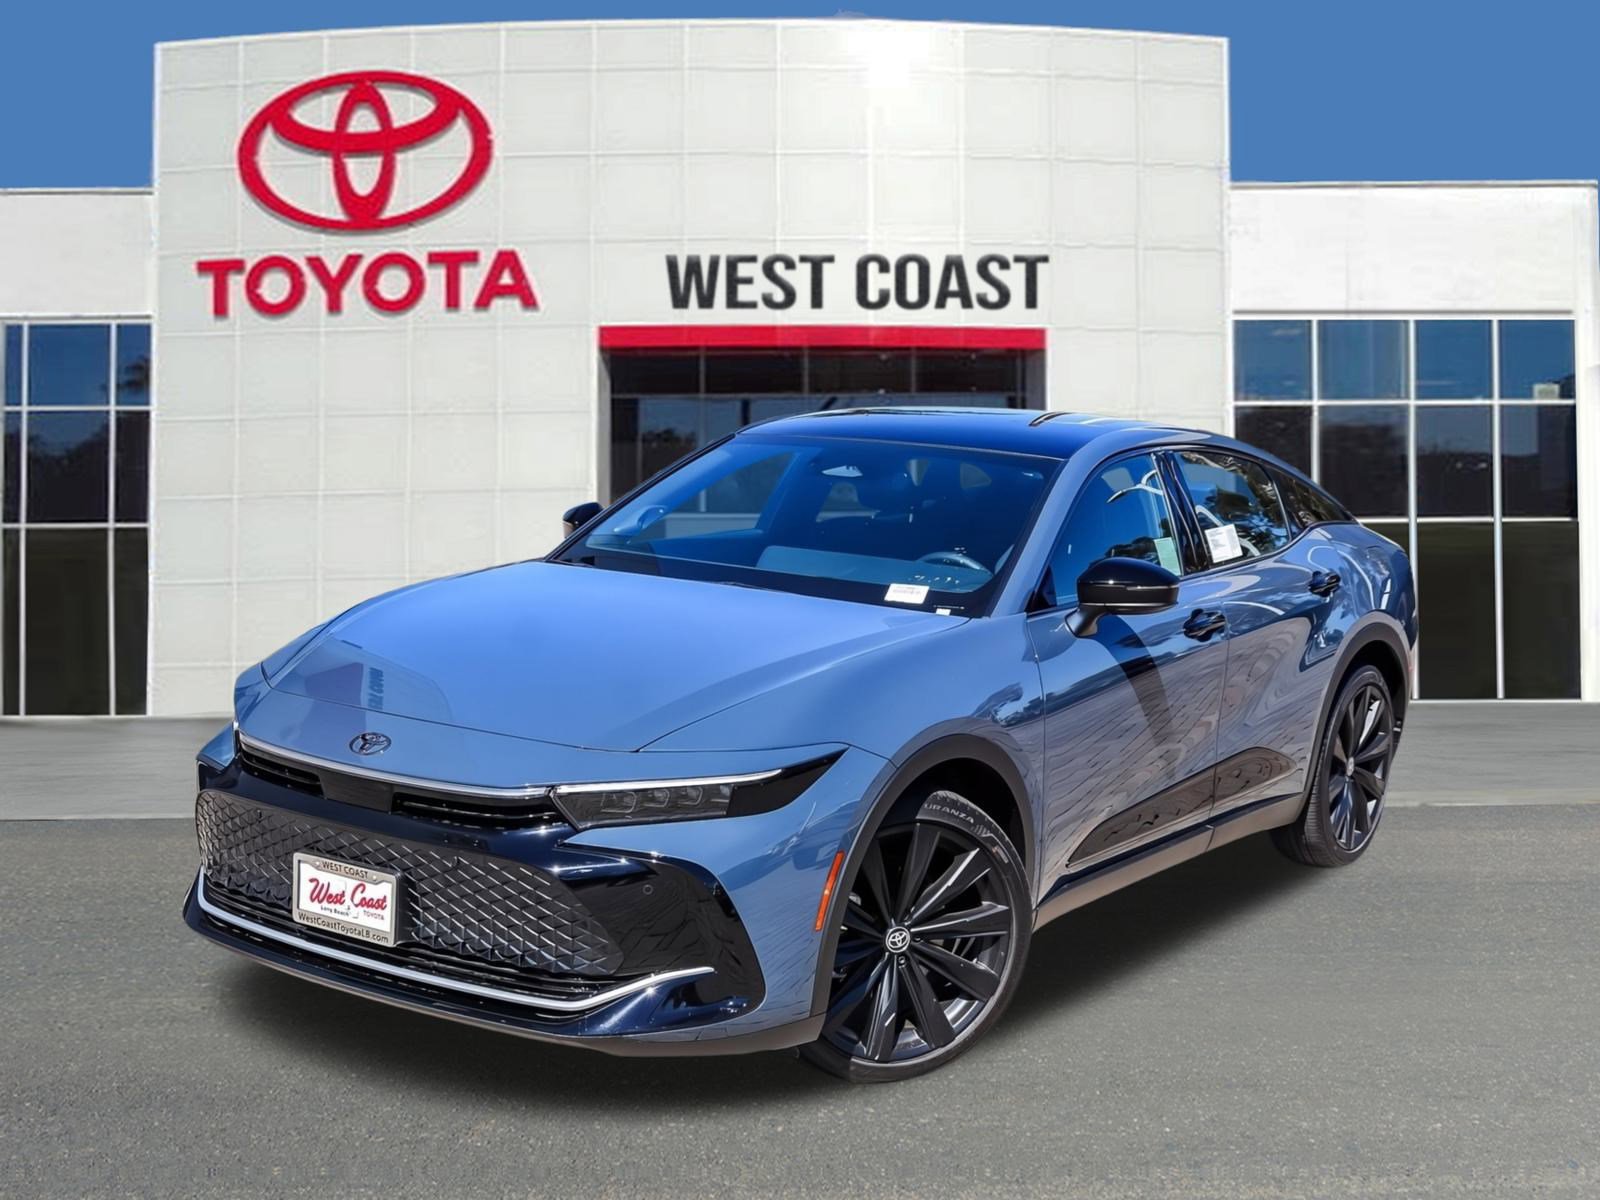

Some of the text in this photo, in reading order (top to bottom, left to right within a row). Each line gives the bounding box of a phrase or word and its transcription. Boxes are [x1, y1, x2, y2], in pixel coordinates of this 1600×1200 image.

[197, 250, 538, 317] TOYOTA
[666, 254, 1049, 310] WEST COAST
[923, 803, 974, 823] URANZA
[322, 861, 368, 878] WEST COAST
[308, 878, 387, 910] West Coast
[298, 912, 389, 943] WestCoastToyotaLB.com
[363, 910, 385, 920] TOYOTA
